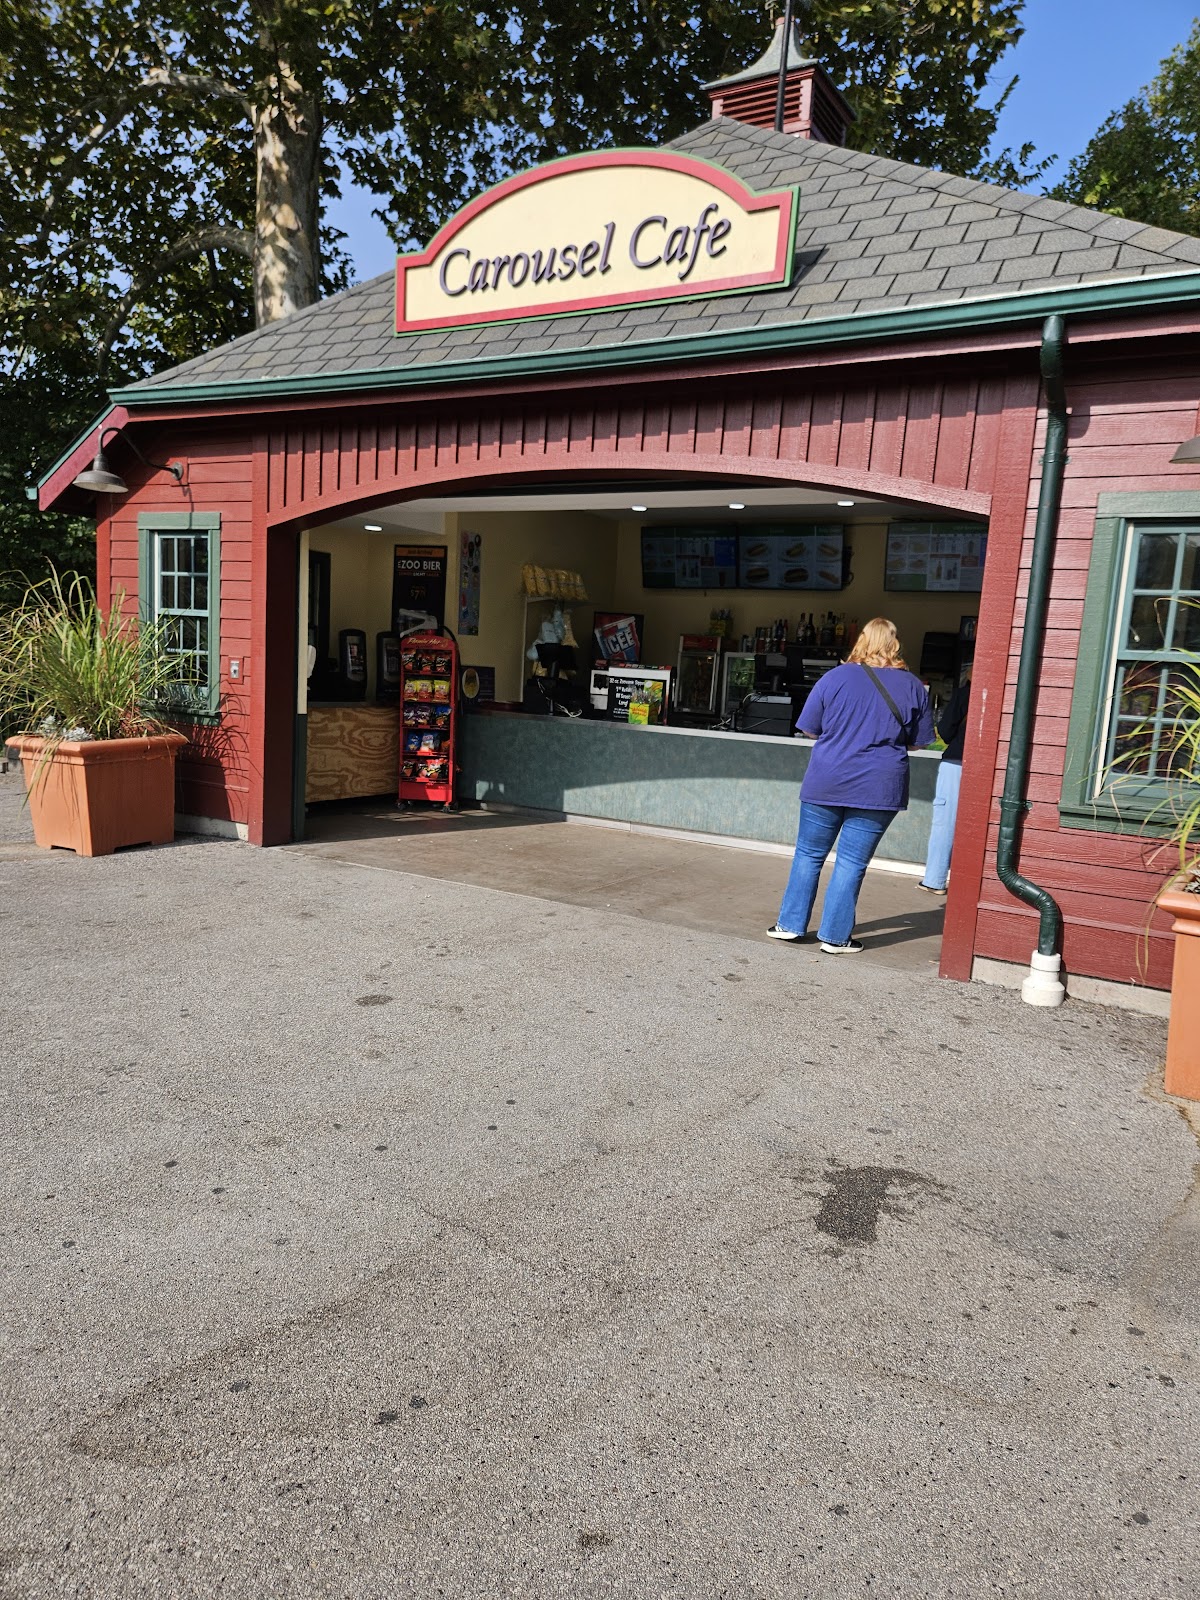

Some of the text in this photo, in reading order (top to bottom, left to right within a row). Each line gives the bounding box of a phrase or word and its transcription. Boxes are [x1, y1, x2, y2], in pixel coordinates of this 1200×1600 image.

[438, 202, 732, 297] Carousel Cafe
[401, 560, 421, 570] ZOO
[422, 560, 441, 571] BIER
[605, 628, 636, 656] ICEE
